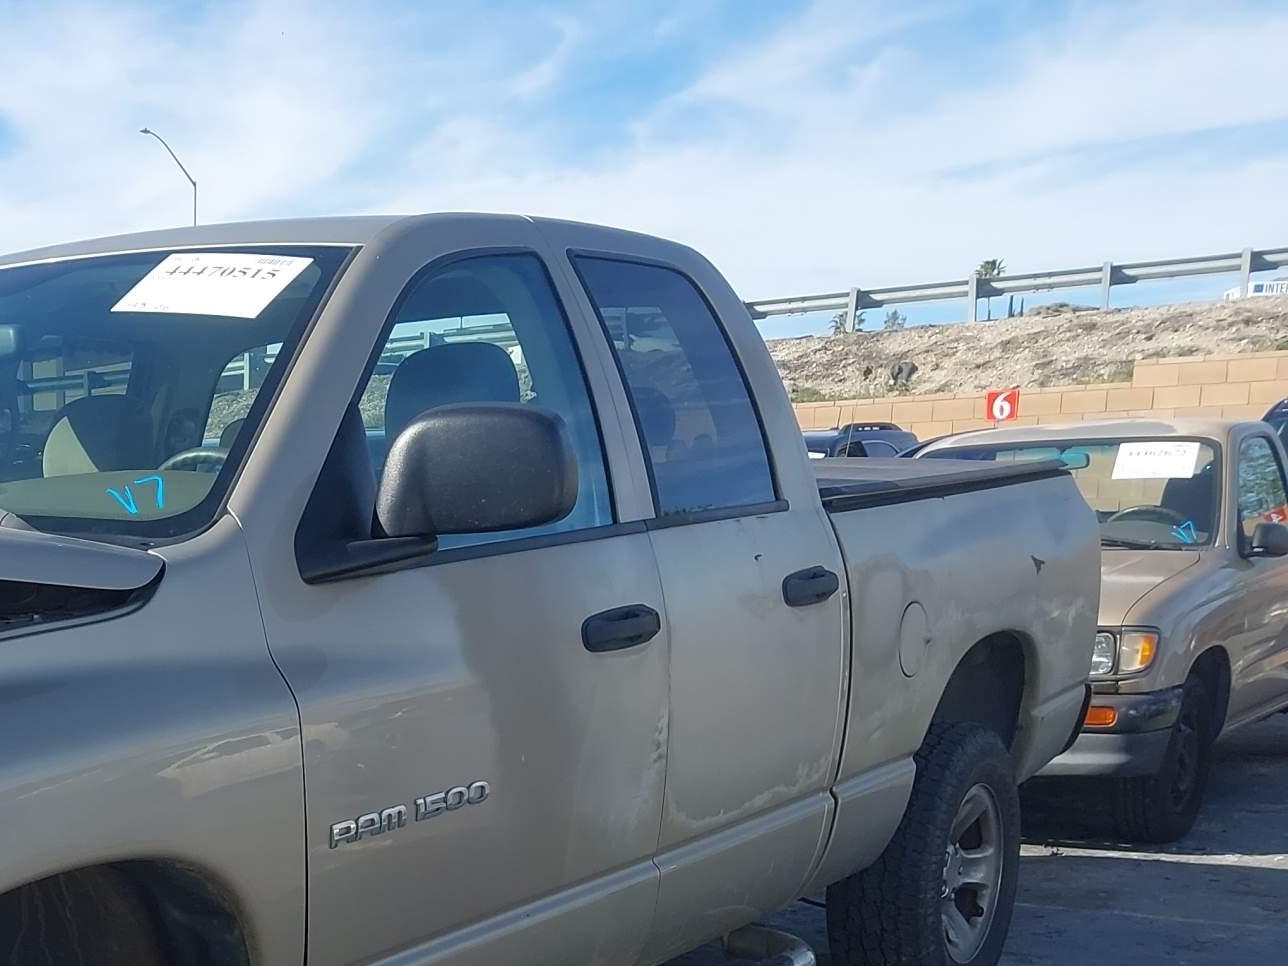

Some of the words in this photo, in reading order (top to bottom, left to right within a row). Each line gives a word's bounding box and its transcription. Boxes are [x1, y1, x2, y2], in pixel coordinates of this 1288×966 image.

[165, 265, 280, 279] 44470515
[992, 391, 1011, 420] 6
[329, 804, 408, 850] RAM
[414, 779, 491, 822] 1500
